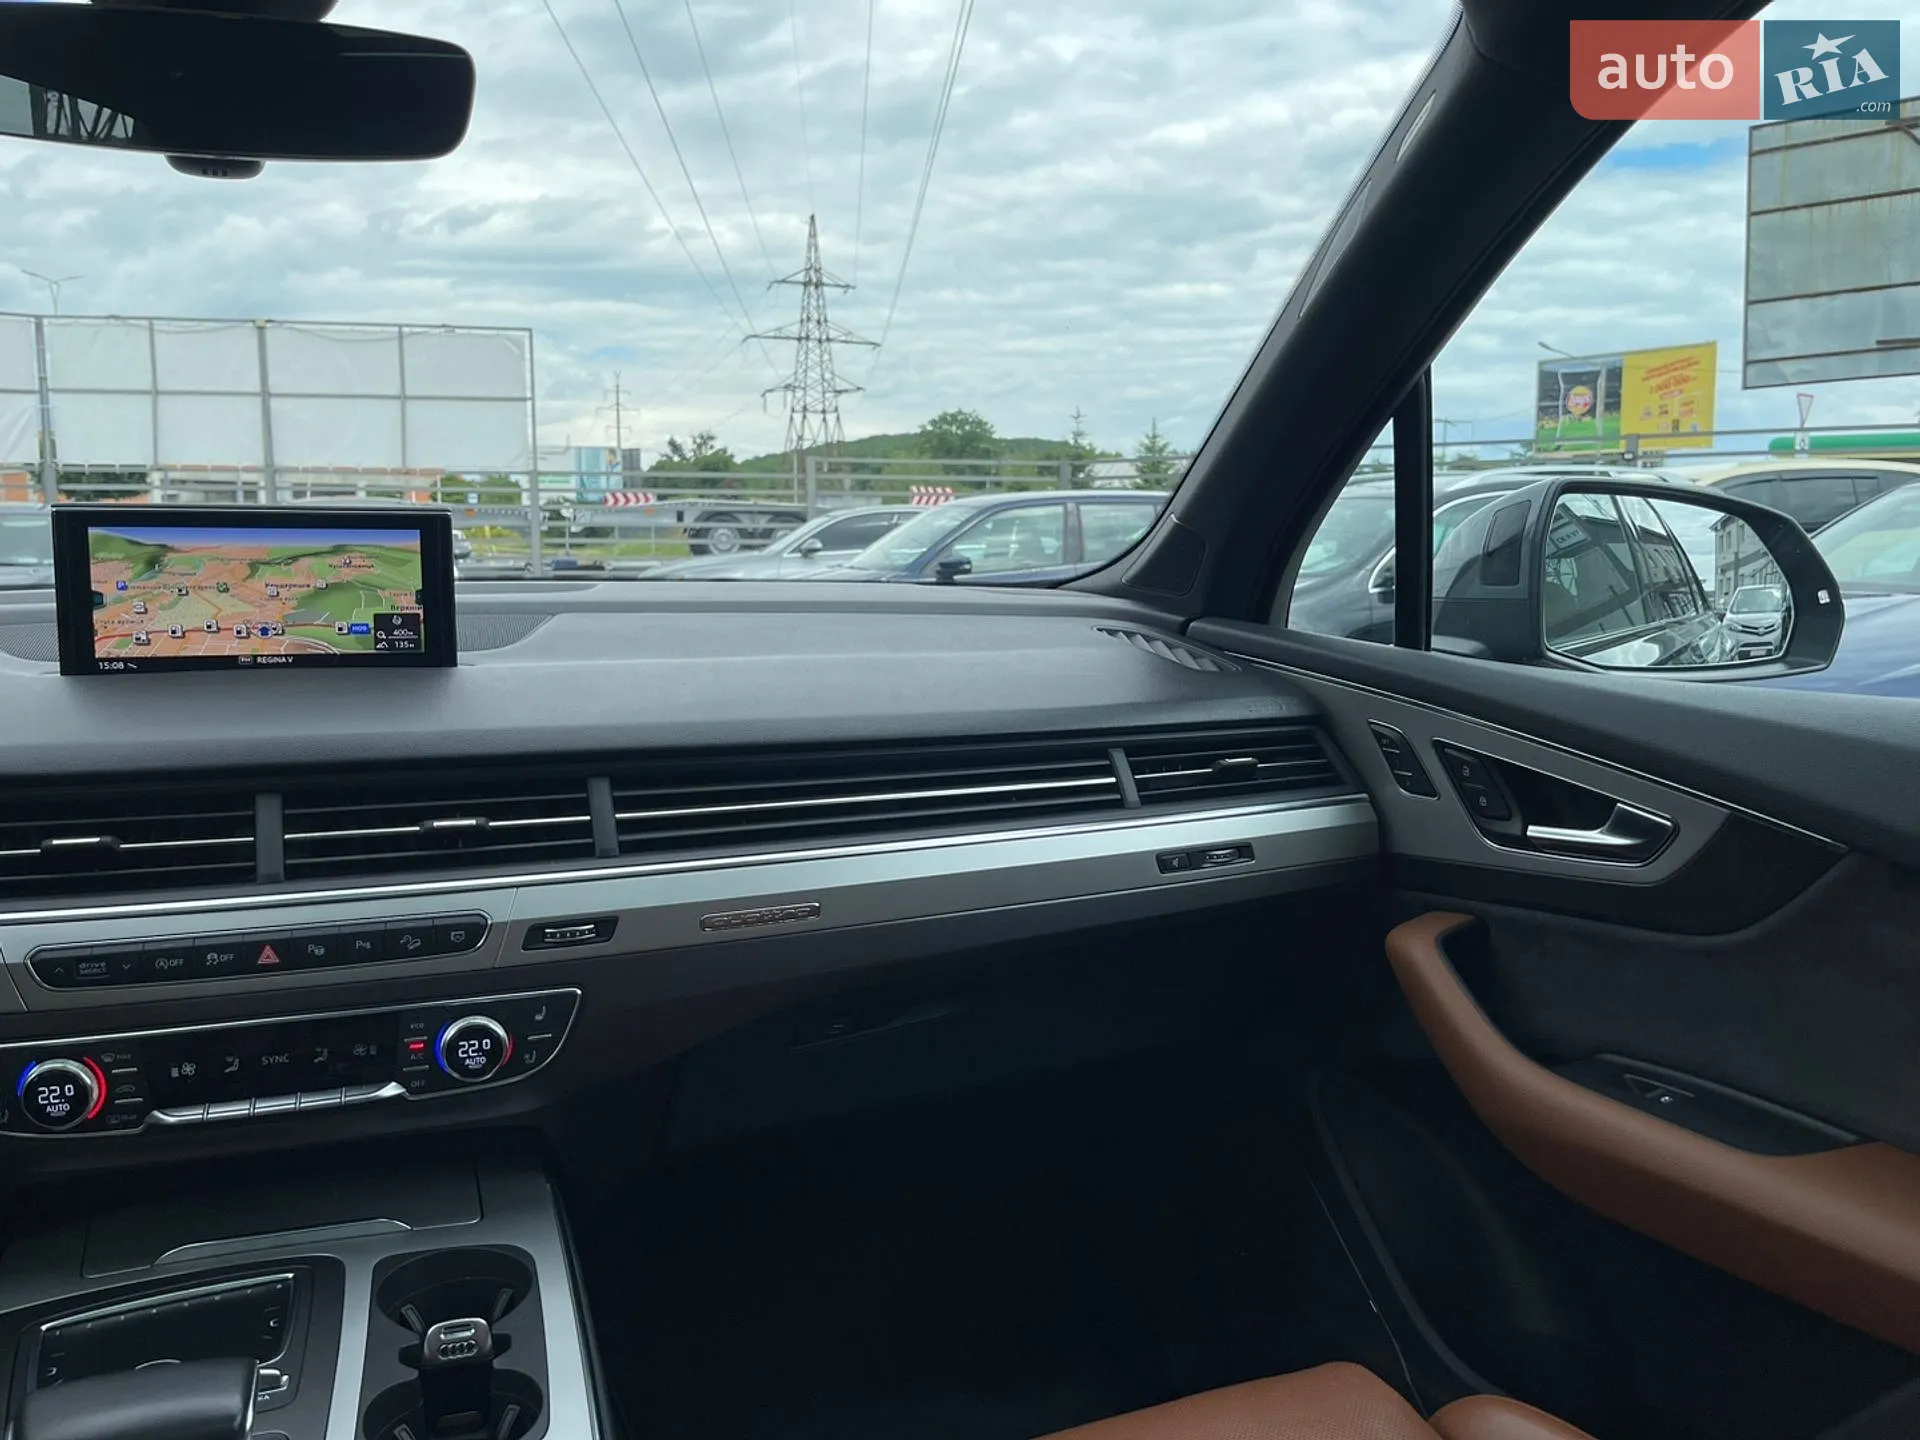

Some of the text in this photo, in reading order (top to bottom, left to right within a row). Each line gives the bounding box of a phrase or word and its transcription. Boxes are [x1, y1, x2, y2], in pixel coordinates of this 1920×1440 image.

[256, 656, 286, 664] REGINA
[99, 661, 124, 670] 15:08
[219, 953, 236, 962] OFF
[79, 961, 106, 969] drive
[169, 958, 184, 967] OFF
[261, 1054, 290, 1066] SYNC
[464, 1057, 486, 1066] AUTO
[45, 1103, 71, 1113] AUTO
